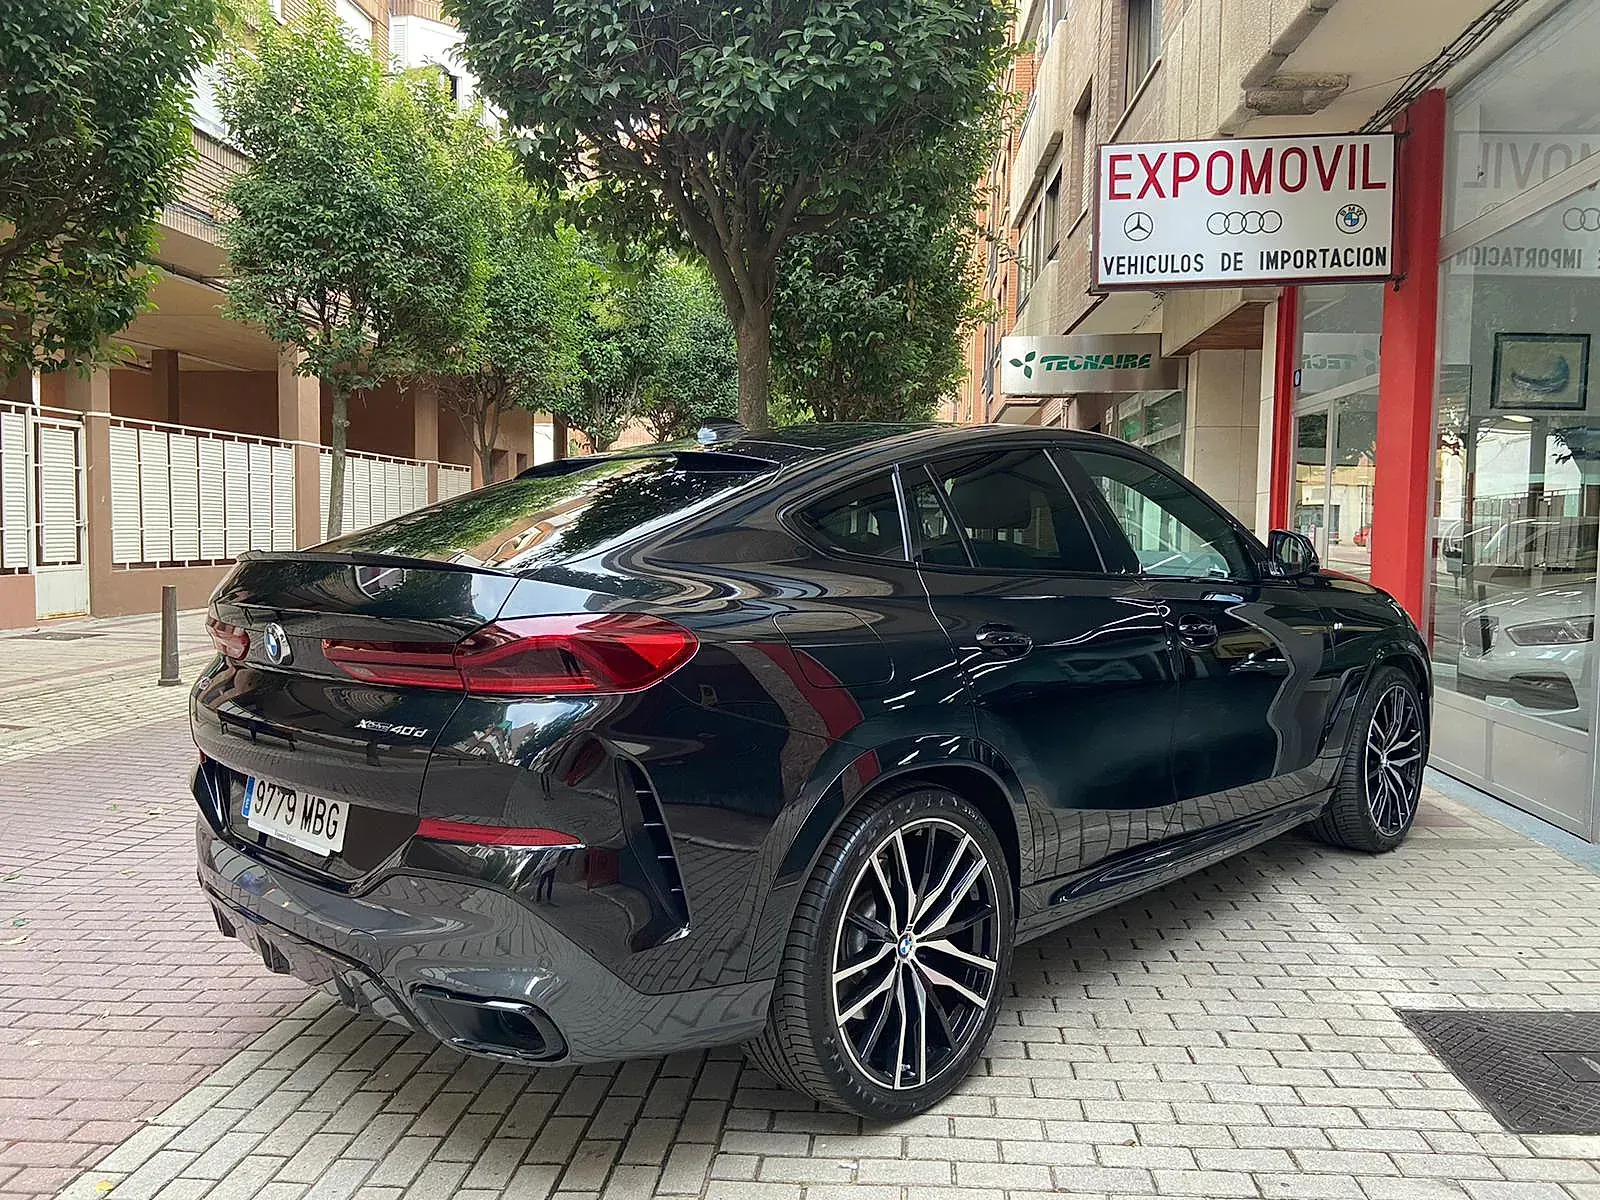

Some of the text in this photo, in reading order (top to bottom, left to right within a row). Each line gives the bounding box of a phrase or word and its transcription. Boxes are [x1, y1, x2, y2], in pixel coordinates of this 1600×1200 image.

[1108, 143, 1387, 201] EXPOMOVIL
[1103, 246, 1387, 276] VEHICULOS DE IMPORTACION
[1039, 353, 1152, 371] TECNAIRE
[254, 780, 340, 841] 9779 MBG
